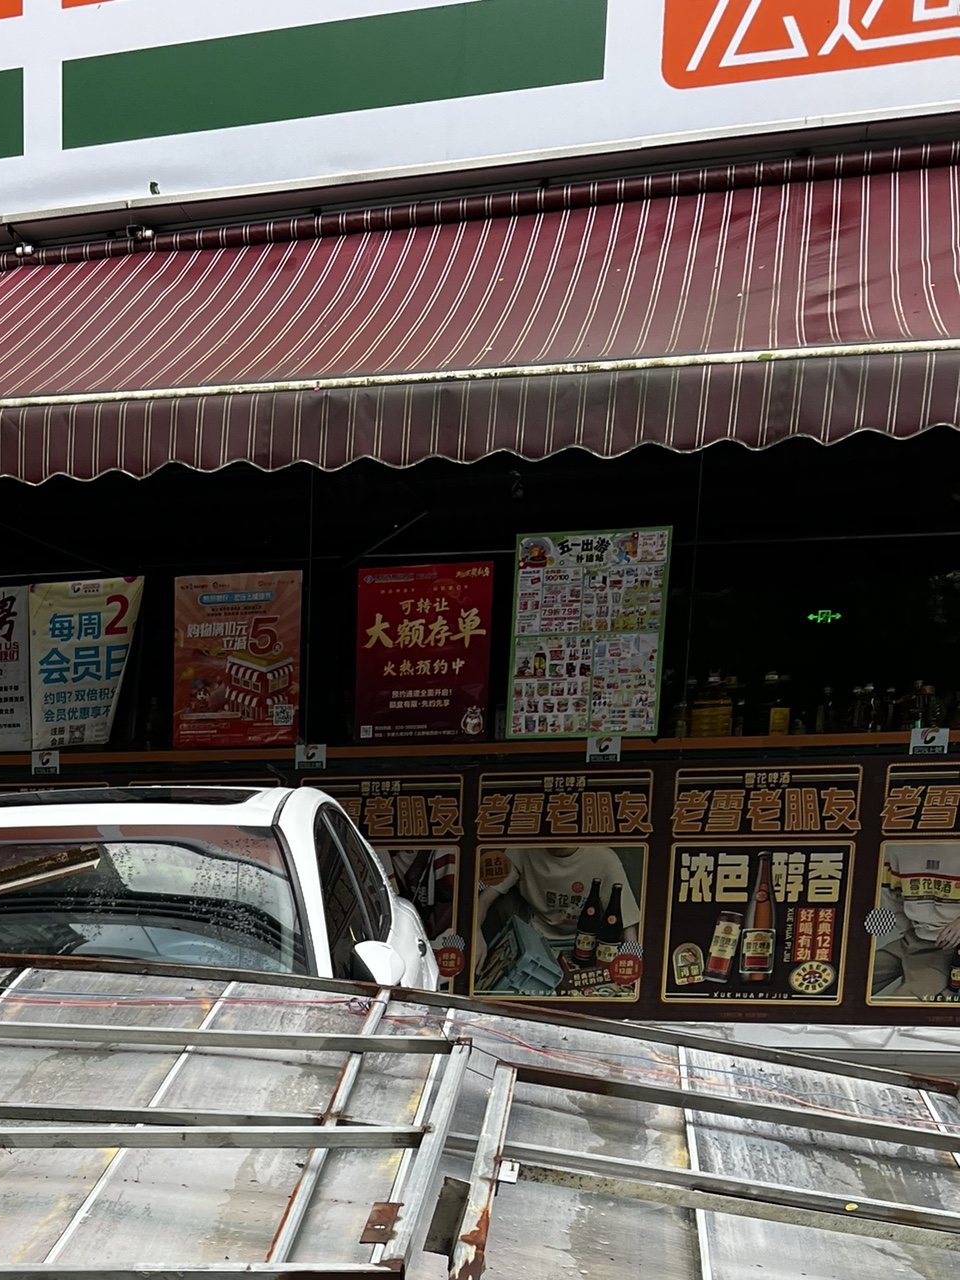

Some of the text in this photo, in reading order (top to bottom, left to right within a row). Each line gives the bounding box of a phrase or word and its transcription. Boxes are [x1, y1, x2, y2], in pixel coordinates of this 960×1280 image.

[558, 537, 610, 555] 五一出游
[399, 598, 450, 616] 可转让
[49, 594, 129, 642] 每周2
[362, 607, 487, 649] 大额存单
[187, 621, 248, 638] 购物满10元
[5, 642, 19, 650] US
[222, 637, 247, 651] 立减
[38, 644, 129, 684] 会员日
[382, 657, 466, 677] 火热预约中
[360, 781, 401, 792] 雪花啤酒
[543, 776, 586, 788] 雪花啤酒
[744, 772, 790, 784] 雪花啤酒
[474, 791, 654, 835] 老雪老朋友
[670, 787, 862, 833] 老雪老朋友
[678, 852, 844, 903] 浓色 醇香
[796, 909, 815, 961] 好喝有劲
[815, 909, 833, 961] 经典12度
